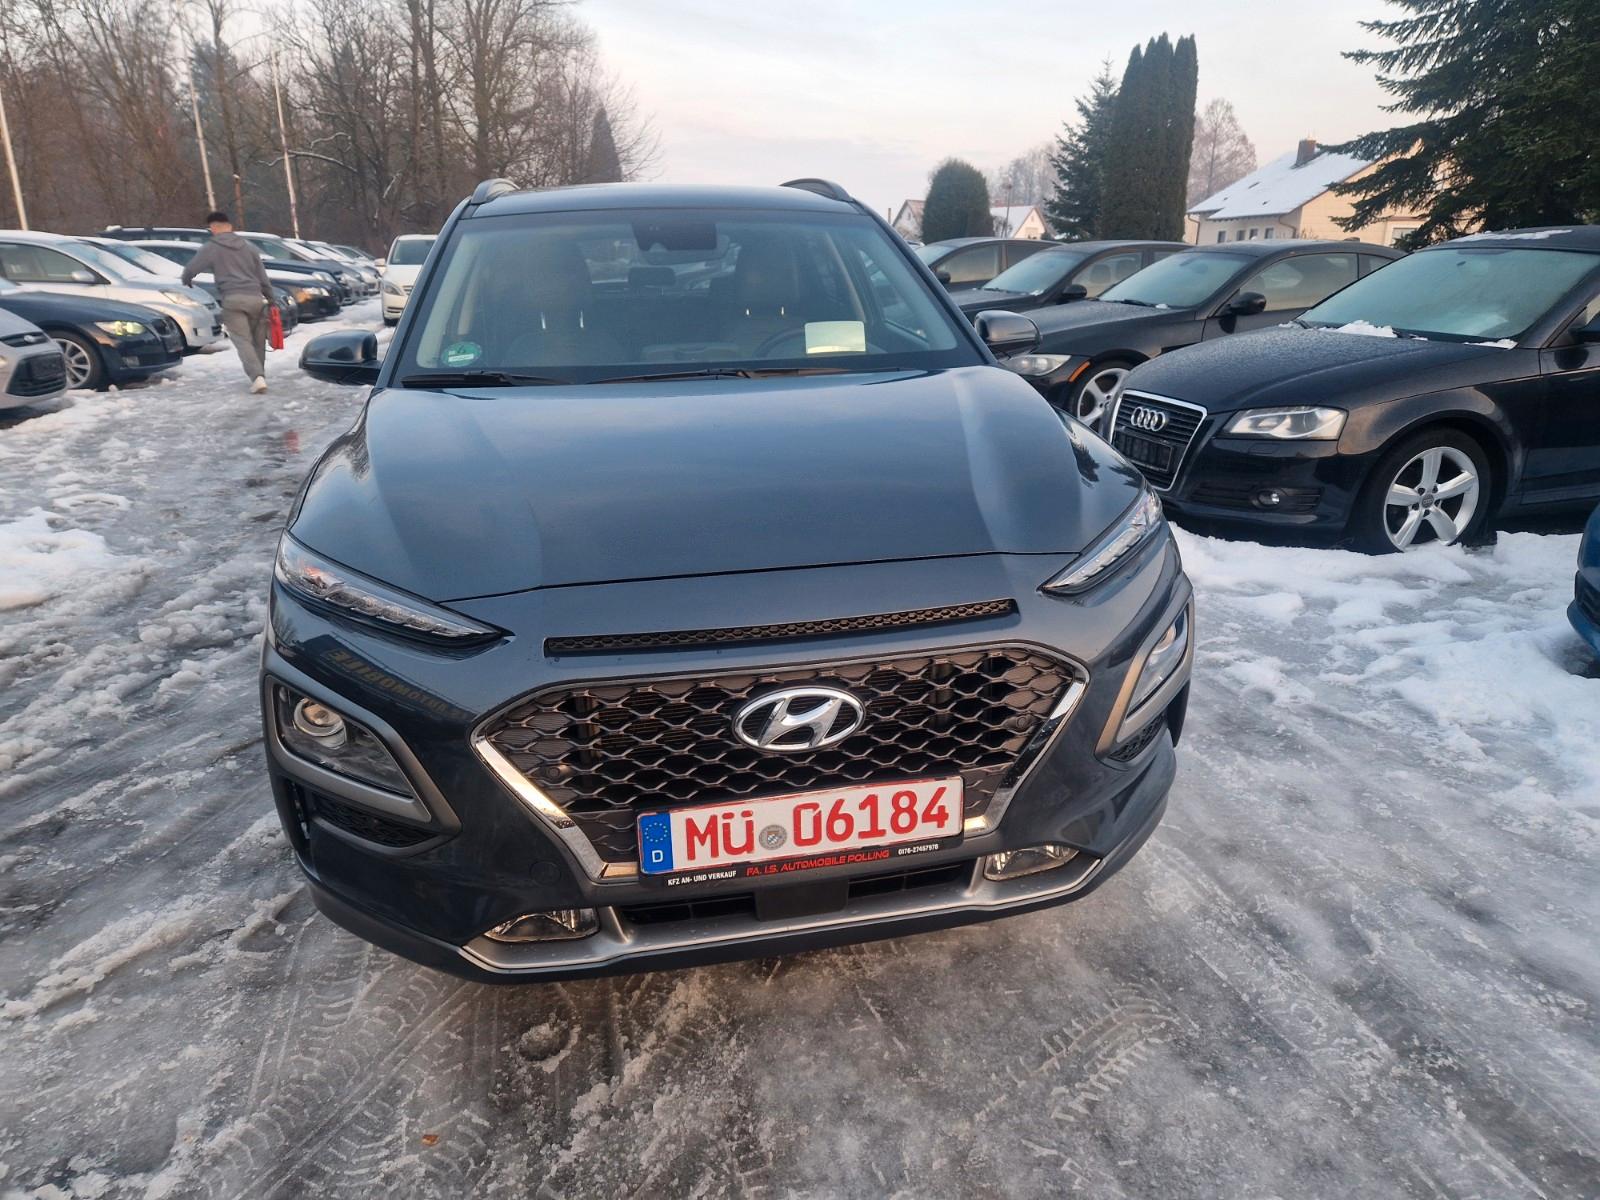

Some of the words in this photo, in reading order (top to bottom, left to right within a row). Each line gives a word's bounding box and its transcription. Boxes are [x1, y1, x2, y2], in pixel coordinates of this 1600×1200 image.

[685, 811, 754, 861] MÜ
[792, 786, 950, 847] 06184
[652, 850, 663, 863] D
[781, 855, 846, 872] AUTOMOBILE
[847, 849, 890, 863] POLLING
[693, 874, 707, 882] UND
[708, 870, 737, 880] VERKAUF
